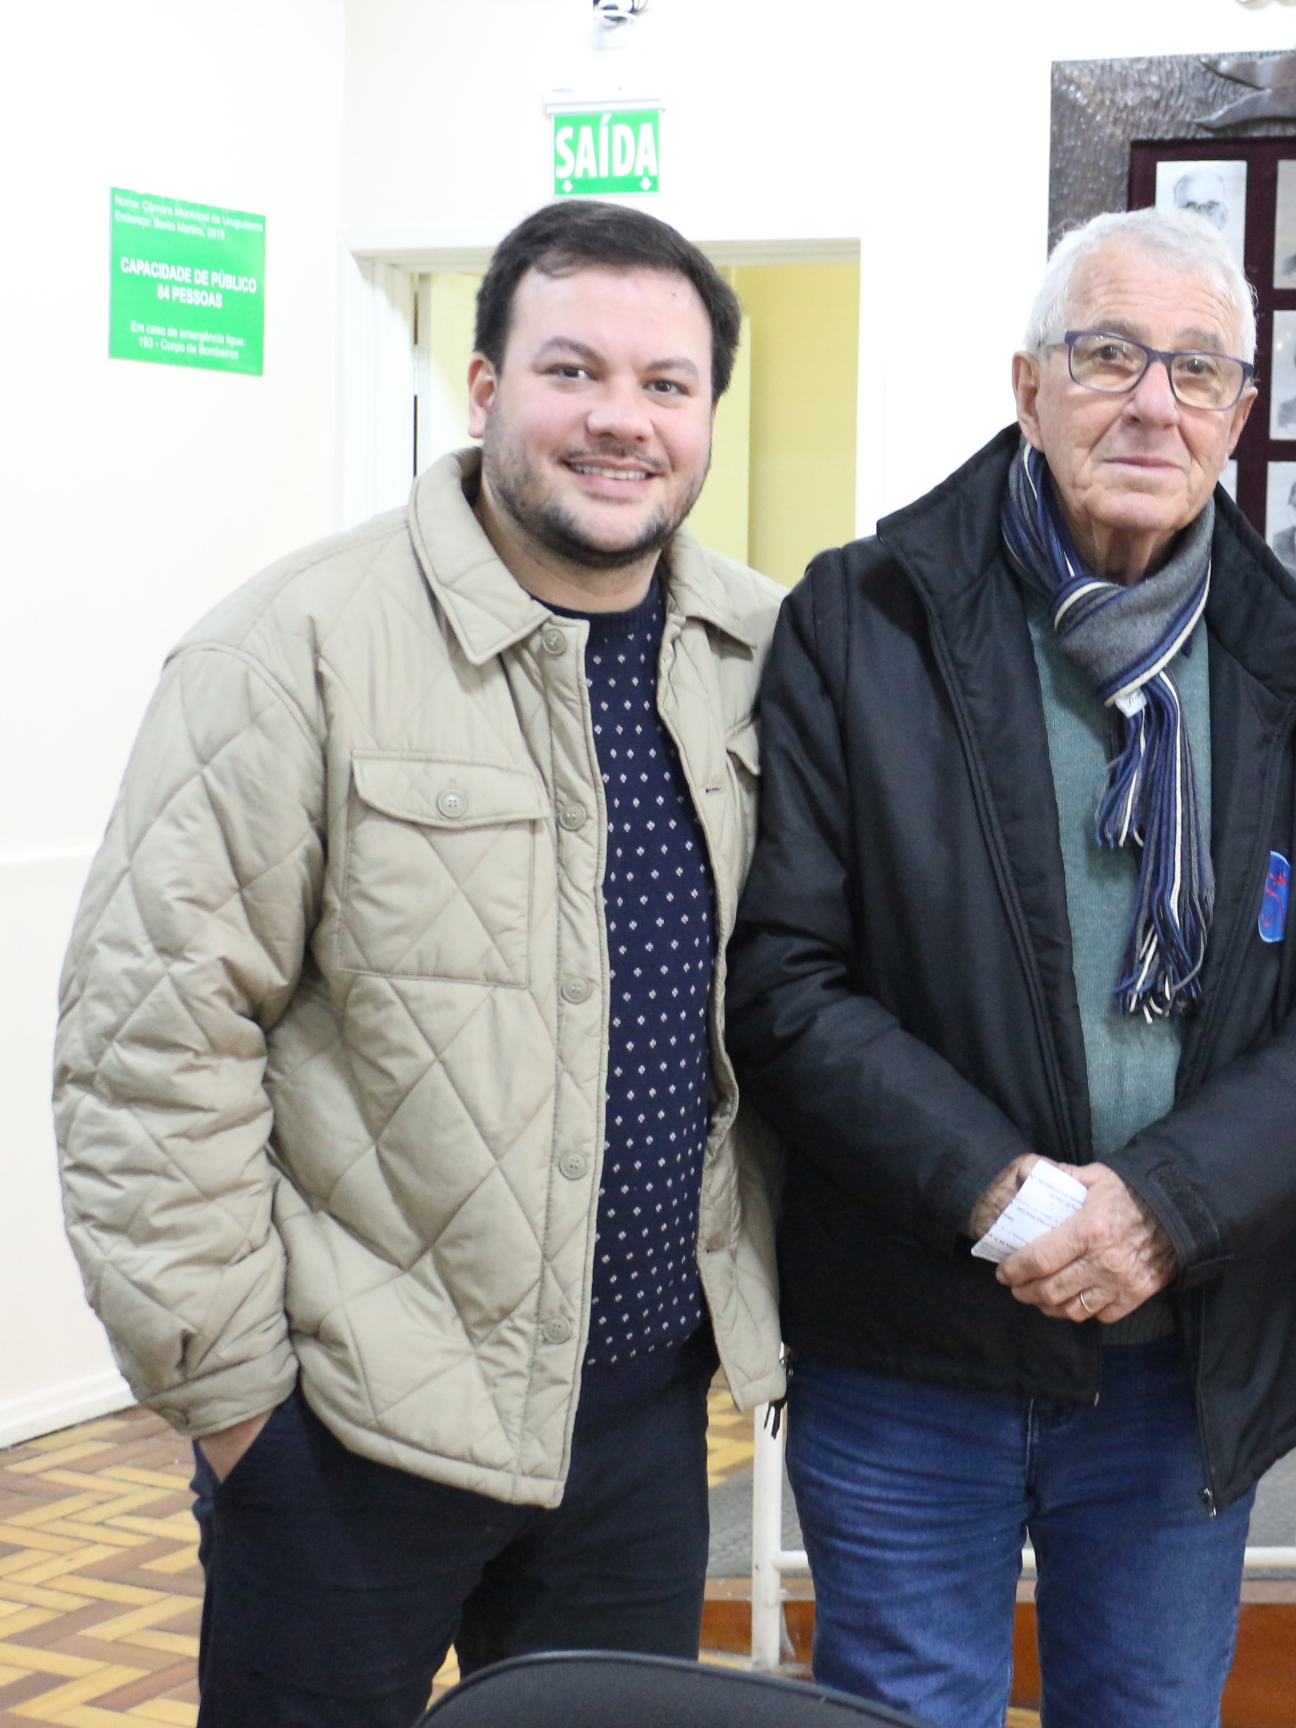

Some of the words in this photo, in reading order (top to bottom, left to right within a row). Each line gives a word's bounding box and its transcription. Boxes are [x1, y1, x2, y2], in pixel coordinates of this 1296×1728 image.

[555, 112, 658, 178] SAÍDA
[142, 199, 173, 216] Câmara
[174, 206, 210, 224] Municipal
[211, 212, 221, 224] de
[222, 215, 264, 233] Uruguaiana
[153, 216, 176, 231] Bento
[120, 256, 192, 284] CAPACIDADE
[194, 268, 209, 286] DE
[211, 269, 257, 293] PÚBLICO
[172, 286, 223, 309] PESSOAS
[130, 320, 145, 333] Em
[146, 323, 166, 336] caso
[167, 326, 178, 337] de
[179, 329, 225, 346] emergência
[139, 336, 154, 349] 193
[160, 339, 186, 355] Corpo
[187, 342, 198, 354] de
[199, 344, 240, 360] Bombeiros
